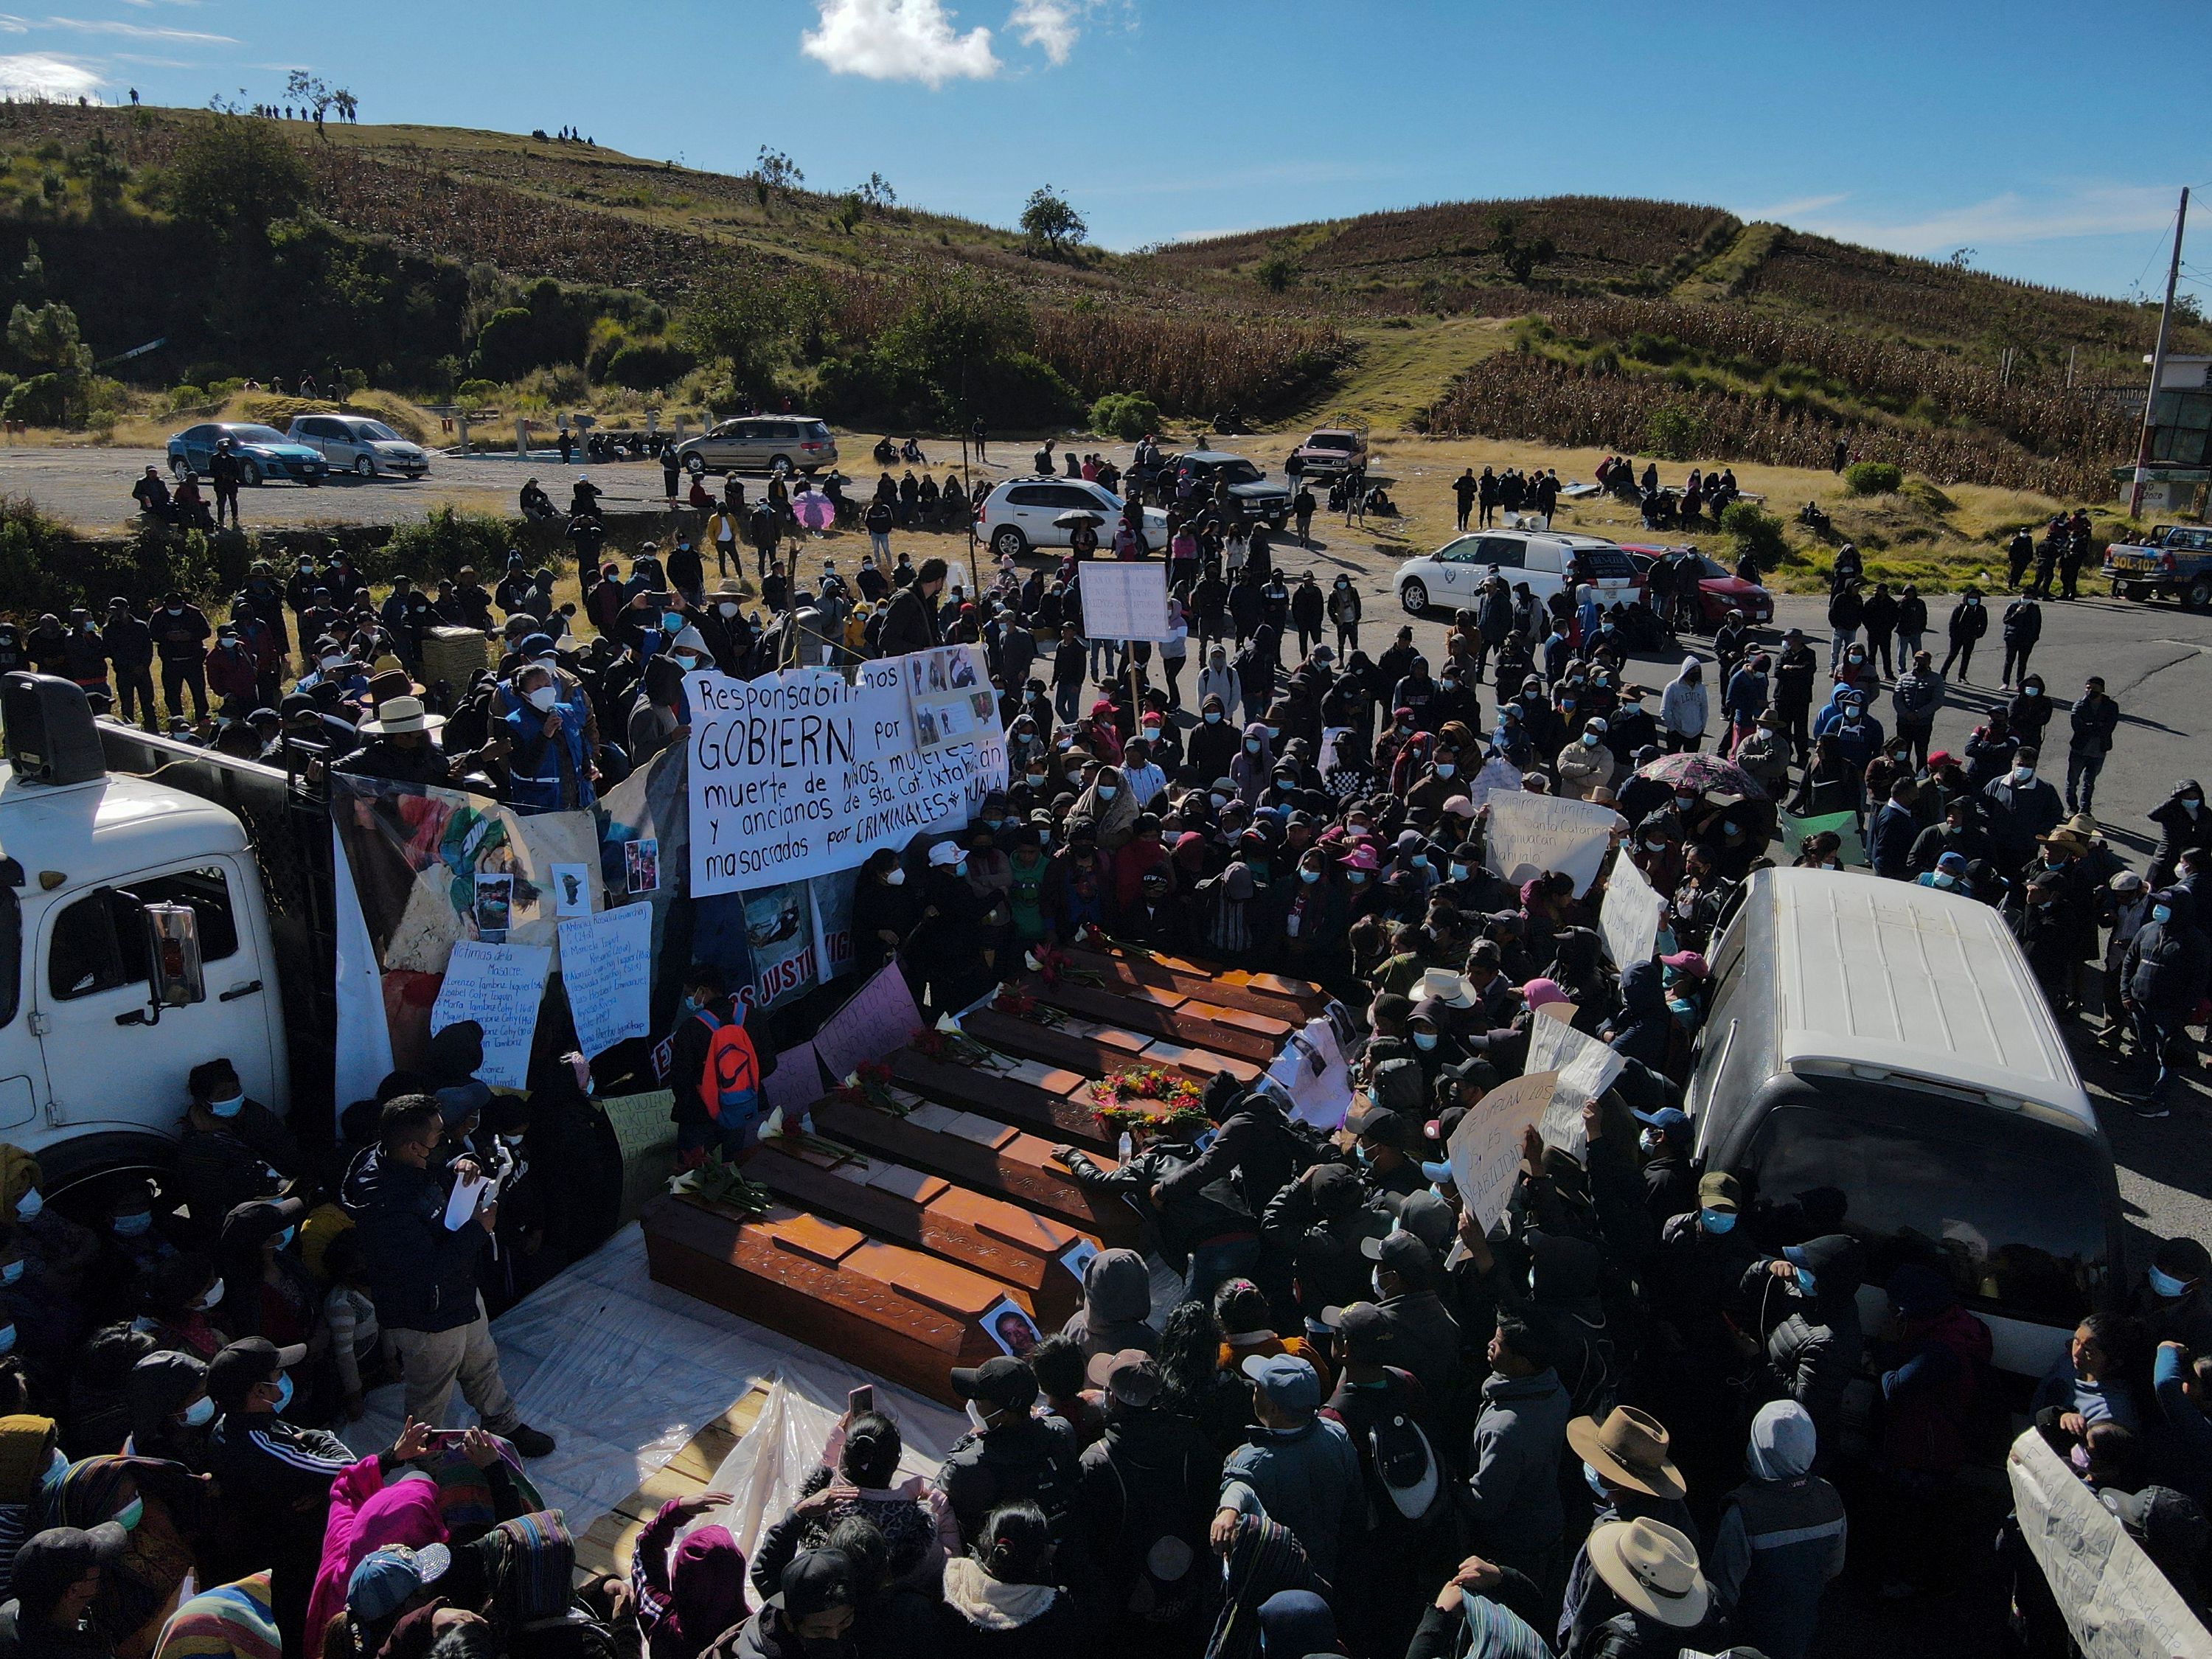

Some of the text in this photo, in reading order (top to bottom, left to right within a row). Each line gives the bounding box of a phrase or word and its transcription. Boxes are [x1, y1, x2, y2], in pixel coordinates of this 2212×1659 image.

[2112, 555, 2158, 572] SOL-107
[698, 714, 900, 771] GOBIERN por
[704, 771, 787, 810] muerte
[804, 770, 827, 795] de
[1490, 793, 1550, 815] Exigimos
[709, 818, 719, 845] y
[742, 797, 834, 835] ancianos
[843, 792, 860, 814] de
[869, 784, 896, 807] Sta.
[898, 771, 925, 796] Cat.
[706, 831, 809, 882] masacrados
[827, 827, 852, 855] por
[855, 793, 950, 844] CRIMINALES
[1524, 815, 1558, 832] Santa
[1560, 819, 1610, 837] Catarina
[1566, 837, 1575, 851] y
[1528, 1084, 1554, 1102] LOS
[2122, 1561, 2183, 1657] Presidente
